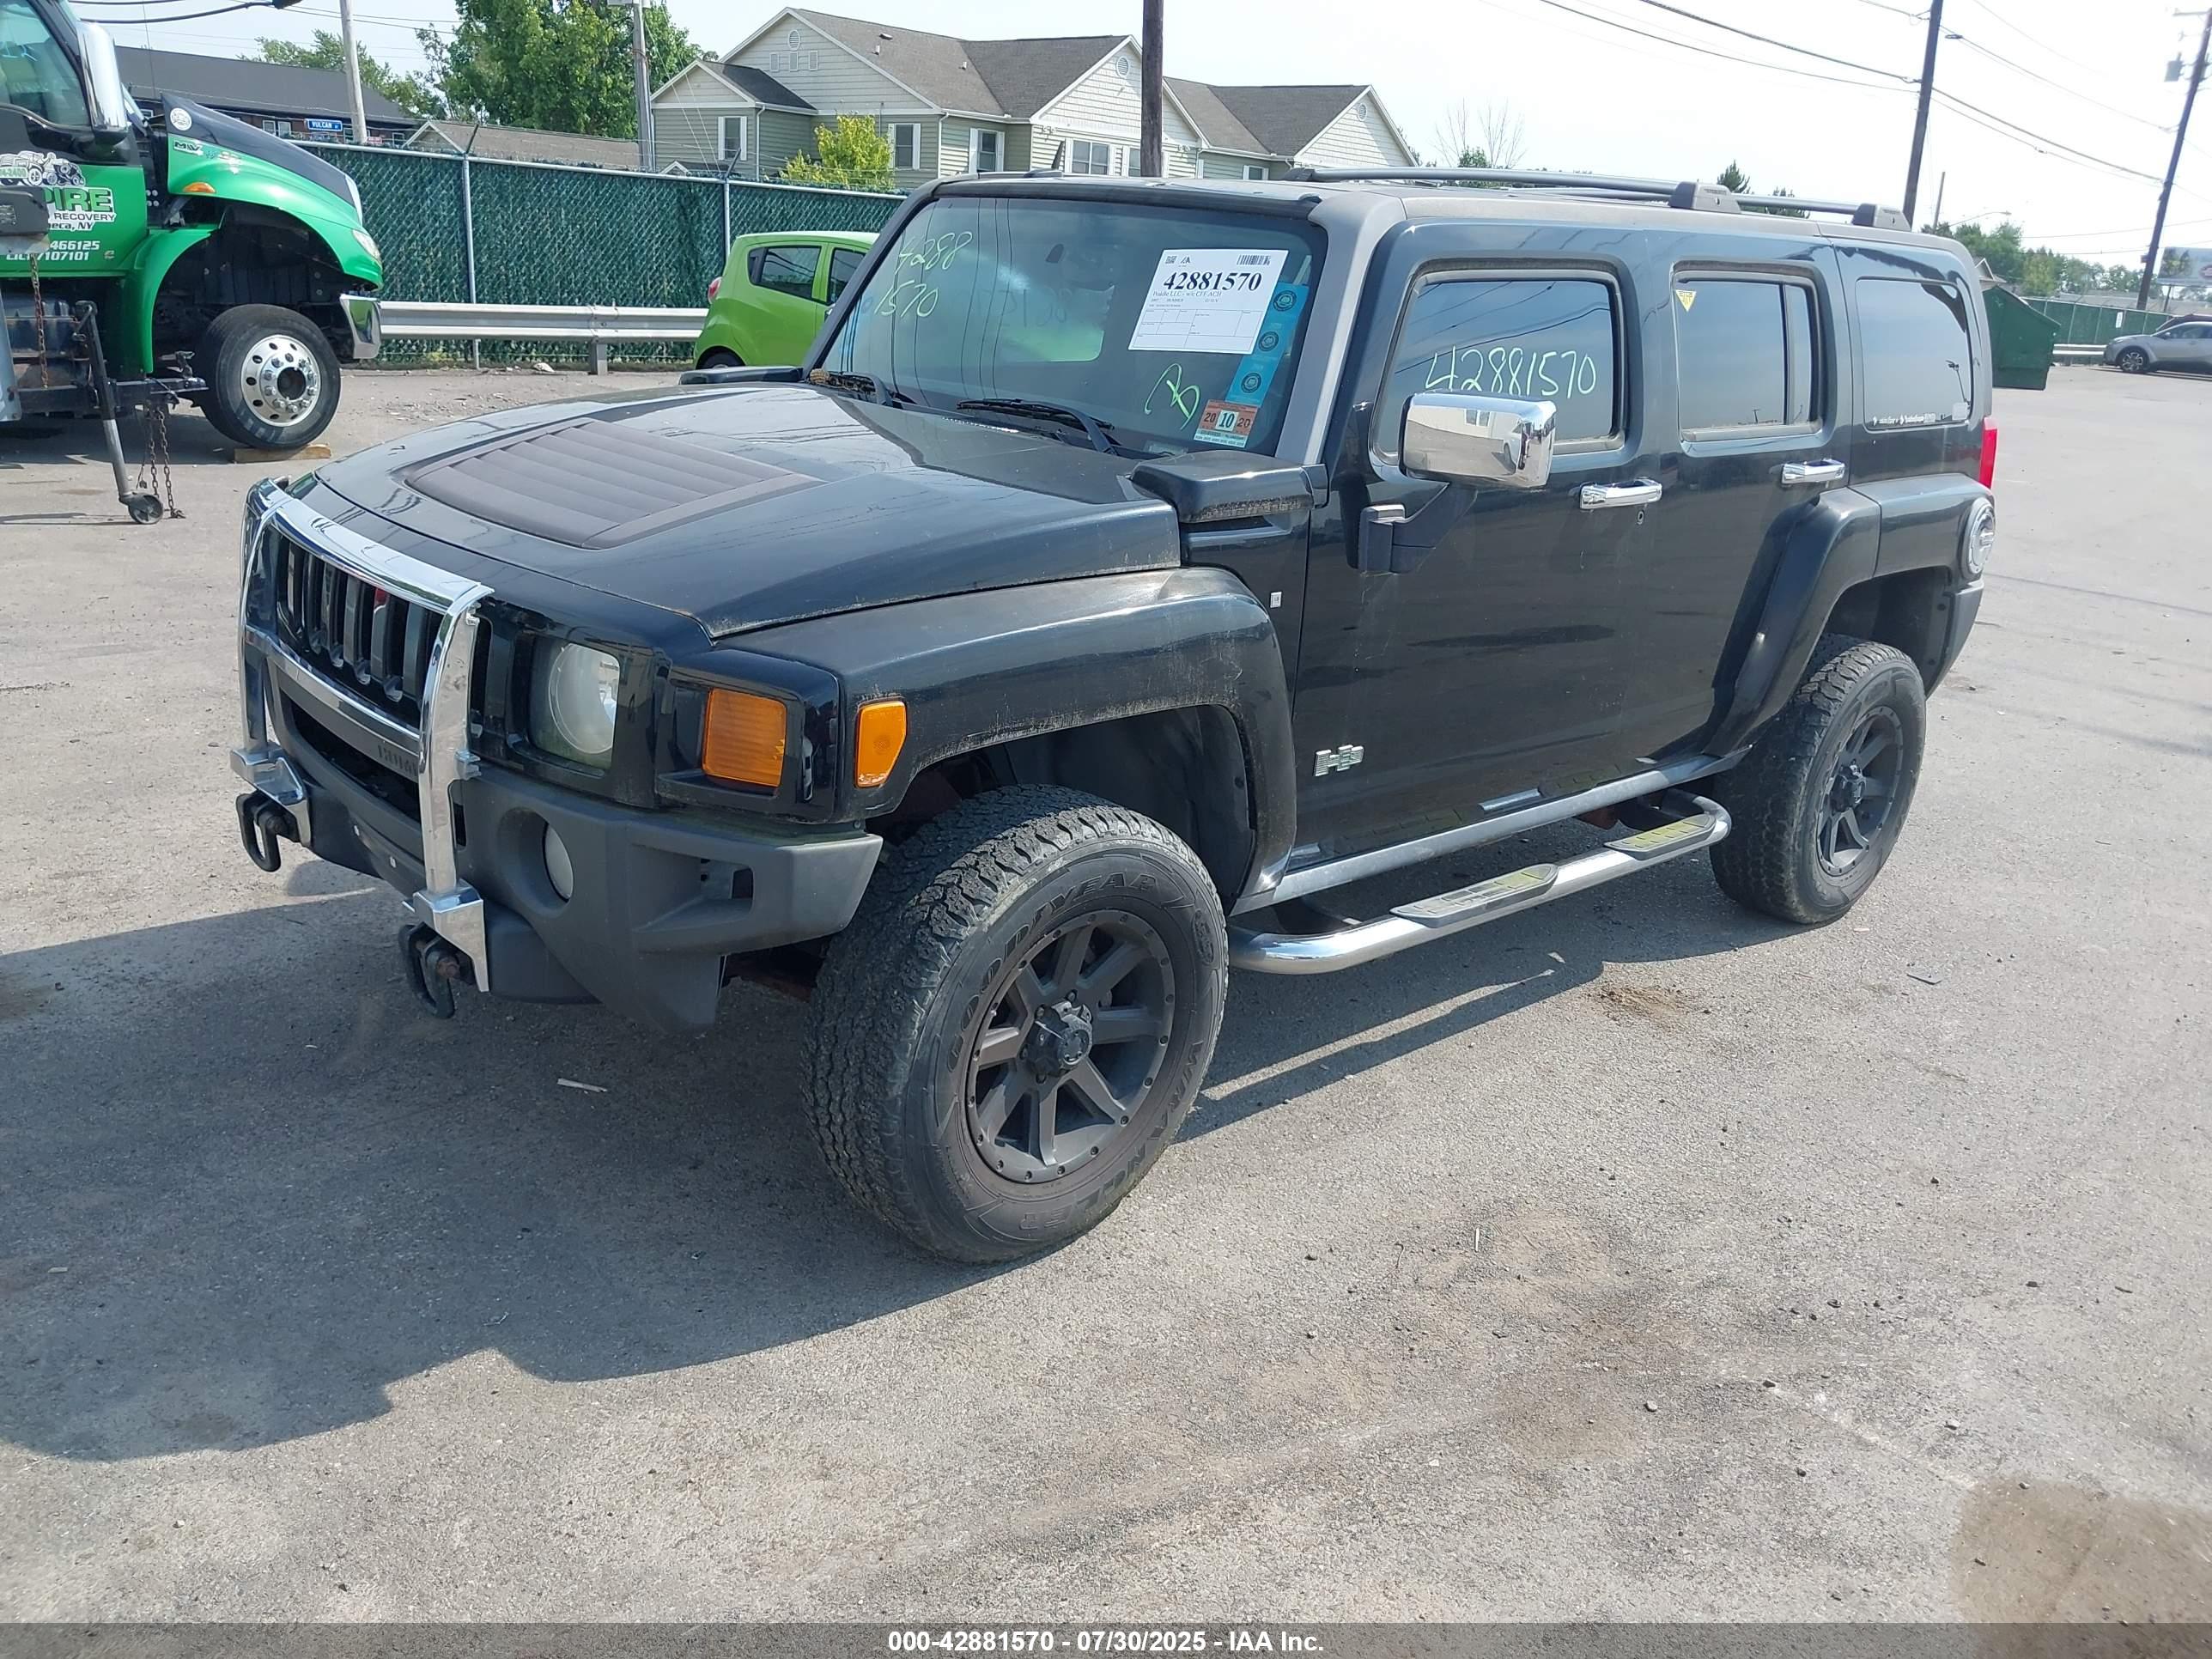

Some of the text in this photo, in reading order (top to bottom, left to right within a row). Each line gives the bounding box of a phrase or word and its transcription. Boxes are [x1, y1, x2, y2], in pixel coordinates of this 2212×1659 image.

[50, 240, 100, 250] 466125
[1164, 272, 1262, 291] 42881570
[874, 280, 939, 318] 1570
[1425, 345, 1596, 398] 42881570
[1204, 413, 1250, 428] 20 10 20
[946, 872, 1158, 1073] GOODYEAR
